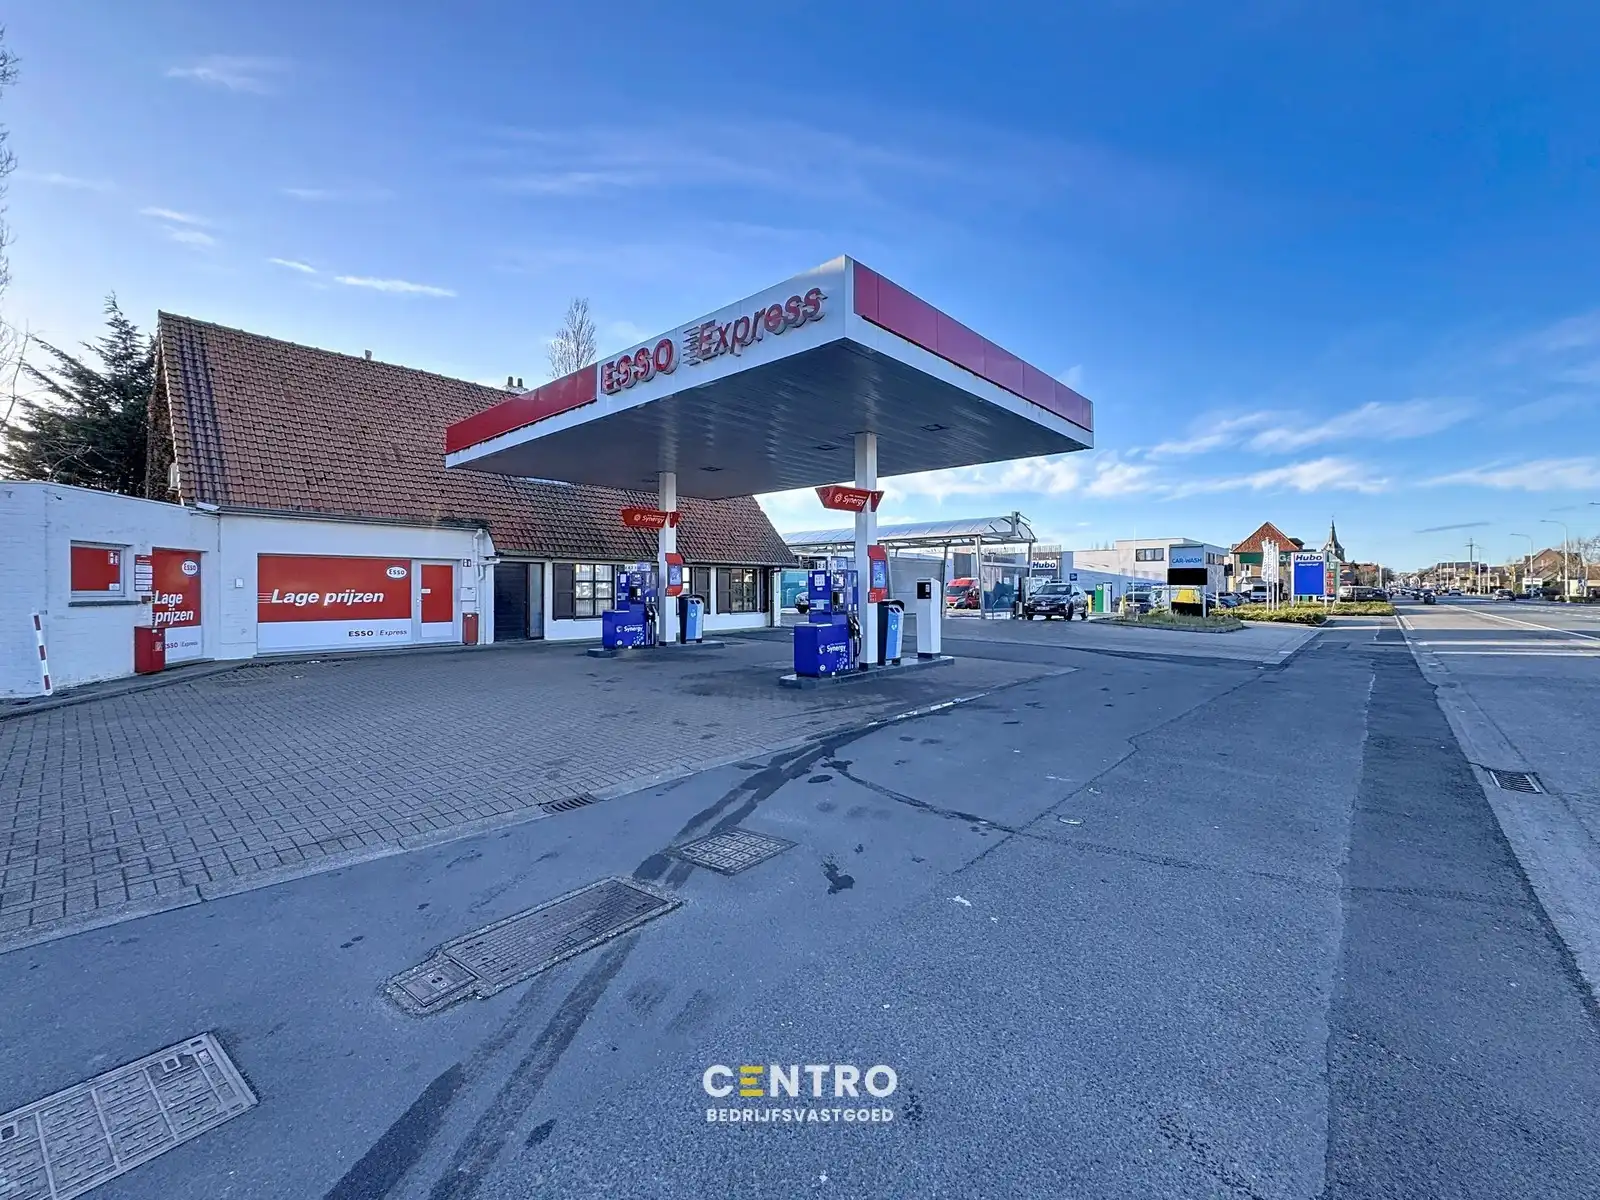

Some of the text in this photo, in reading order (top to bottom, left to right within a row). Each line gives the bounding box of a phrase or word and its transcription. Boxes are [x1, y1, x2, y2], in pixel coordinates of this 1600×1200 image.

[601, 287, 828, 395] ESSO Express
[843, 495, 865, 506] Synergy
[642, 515, 664, 524] Synergy
[183, 562, 197, 571] Esso
[1032, 561, 1056, 569] Hubo
[154, 589, 183, 608] Lage
[271, 589, 385, 607] Lage prijzen
[154, 608, 194, 627] prijzen
[348, 629, 408, 638] ESSO Express
[827, 644, 846, 654] Synergy
